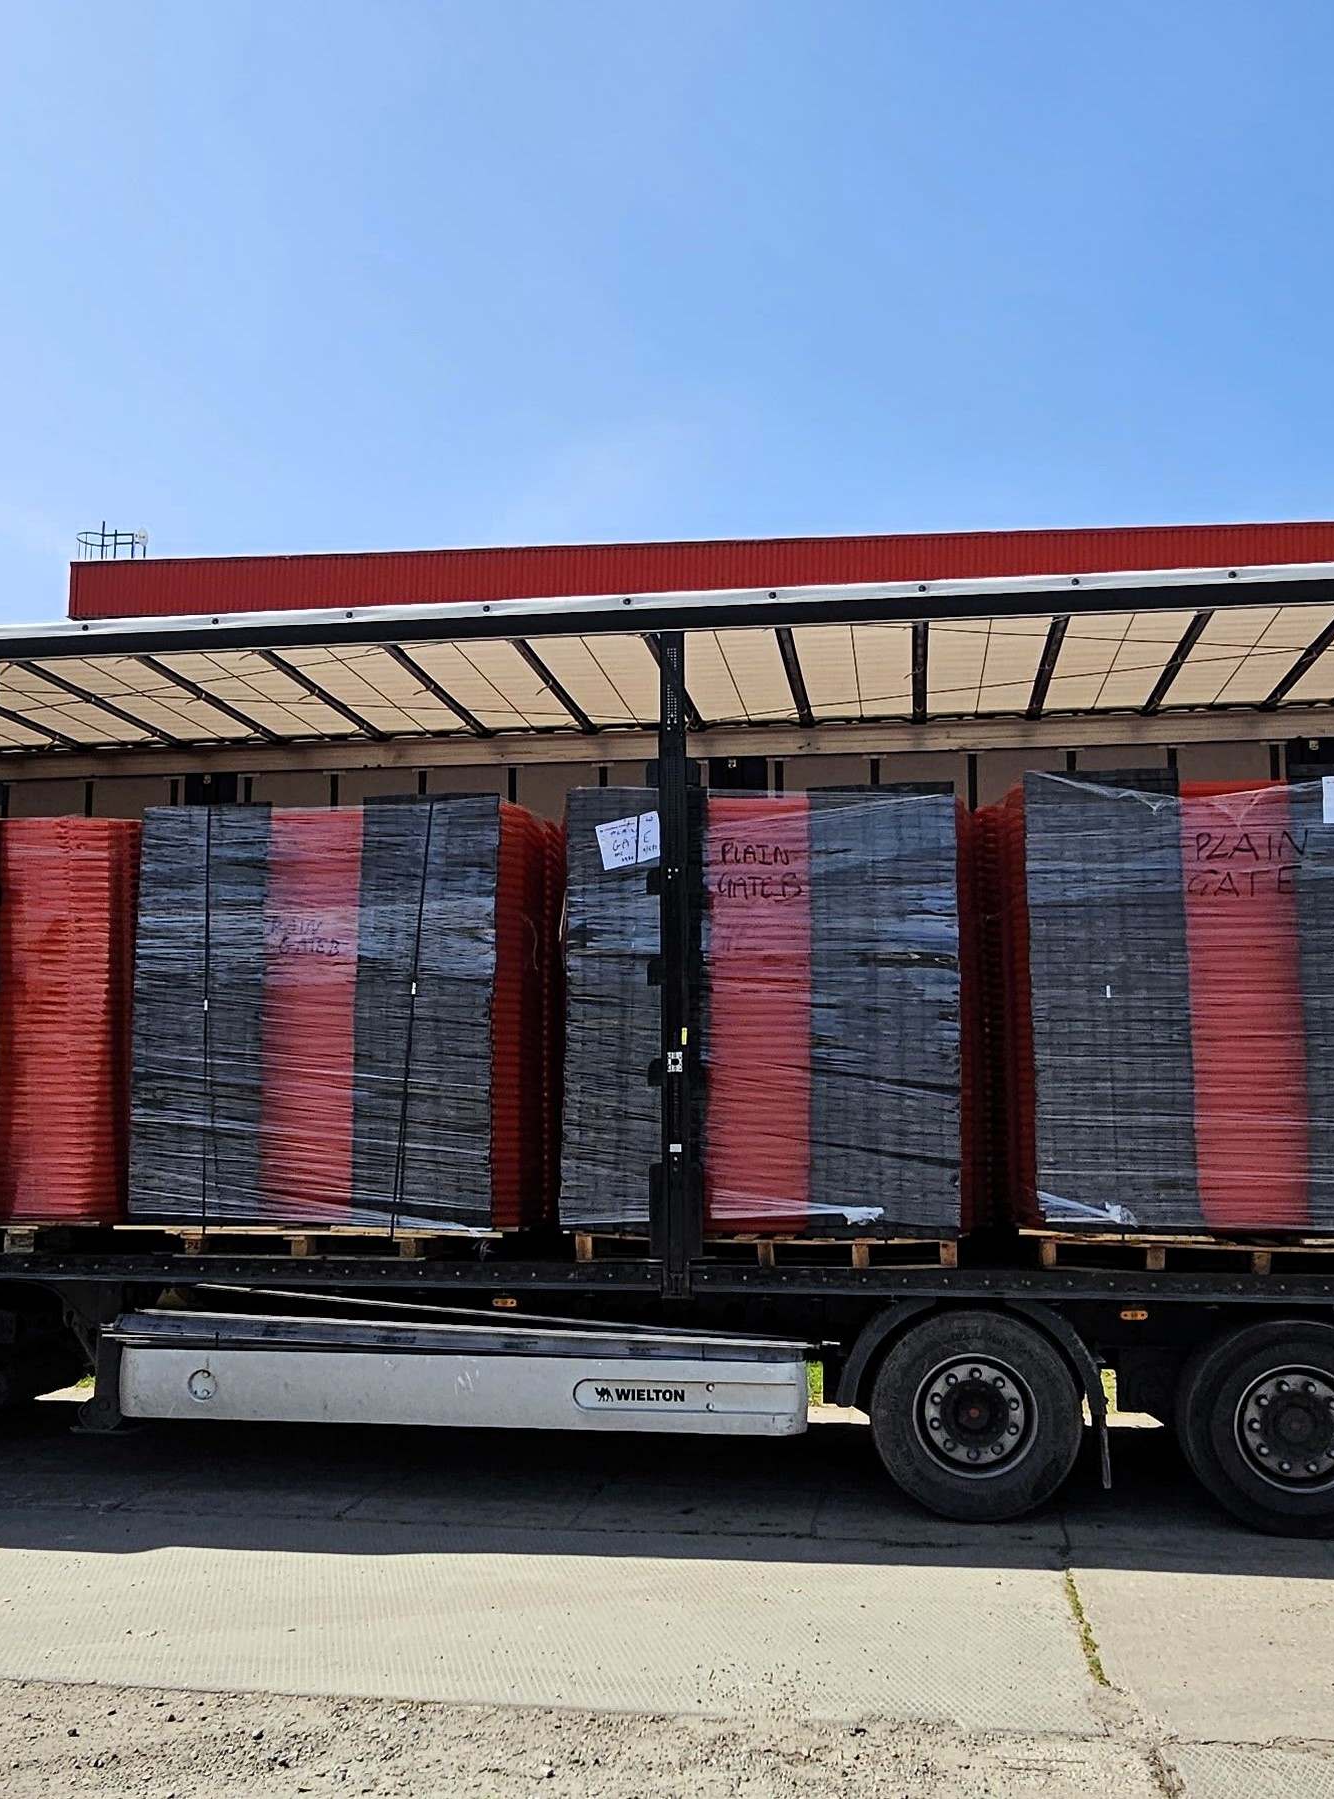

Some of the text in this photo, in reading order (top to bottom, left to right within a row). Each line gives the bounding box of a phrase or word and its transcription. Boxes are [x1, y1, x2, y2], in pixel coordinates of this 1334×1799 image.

[721, 841, 790, 866] PLAIN
[1196, 829, 1308, 861] PLAIN
[1187, 864, 1302, 897] GATE
[615, 1387, 685, 1402] WIELTON
